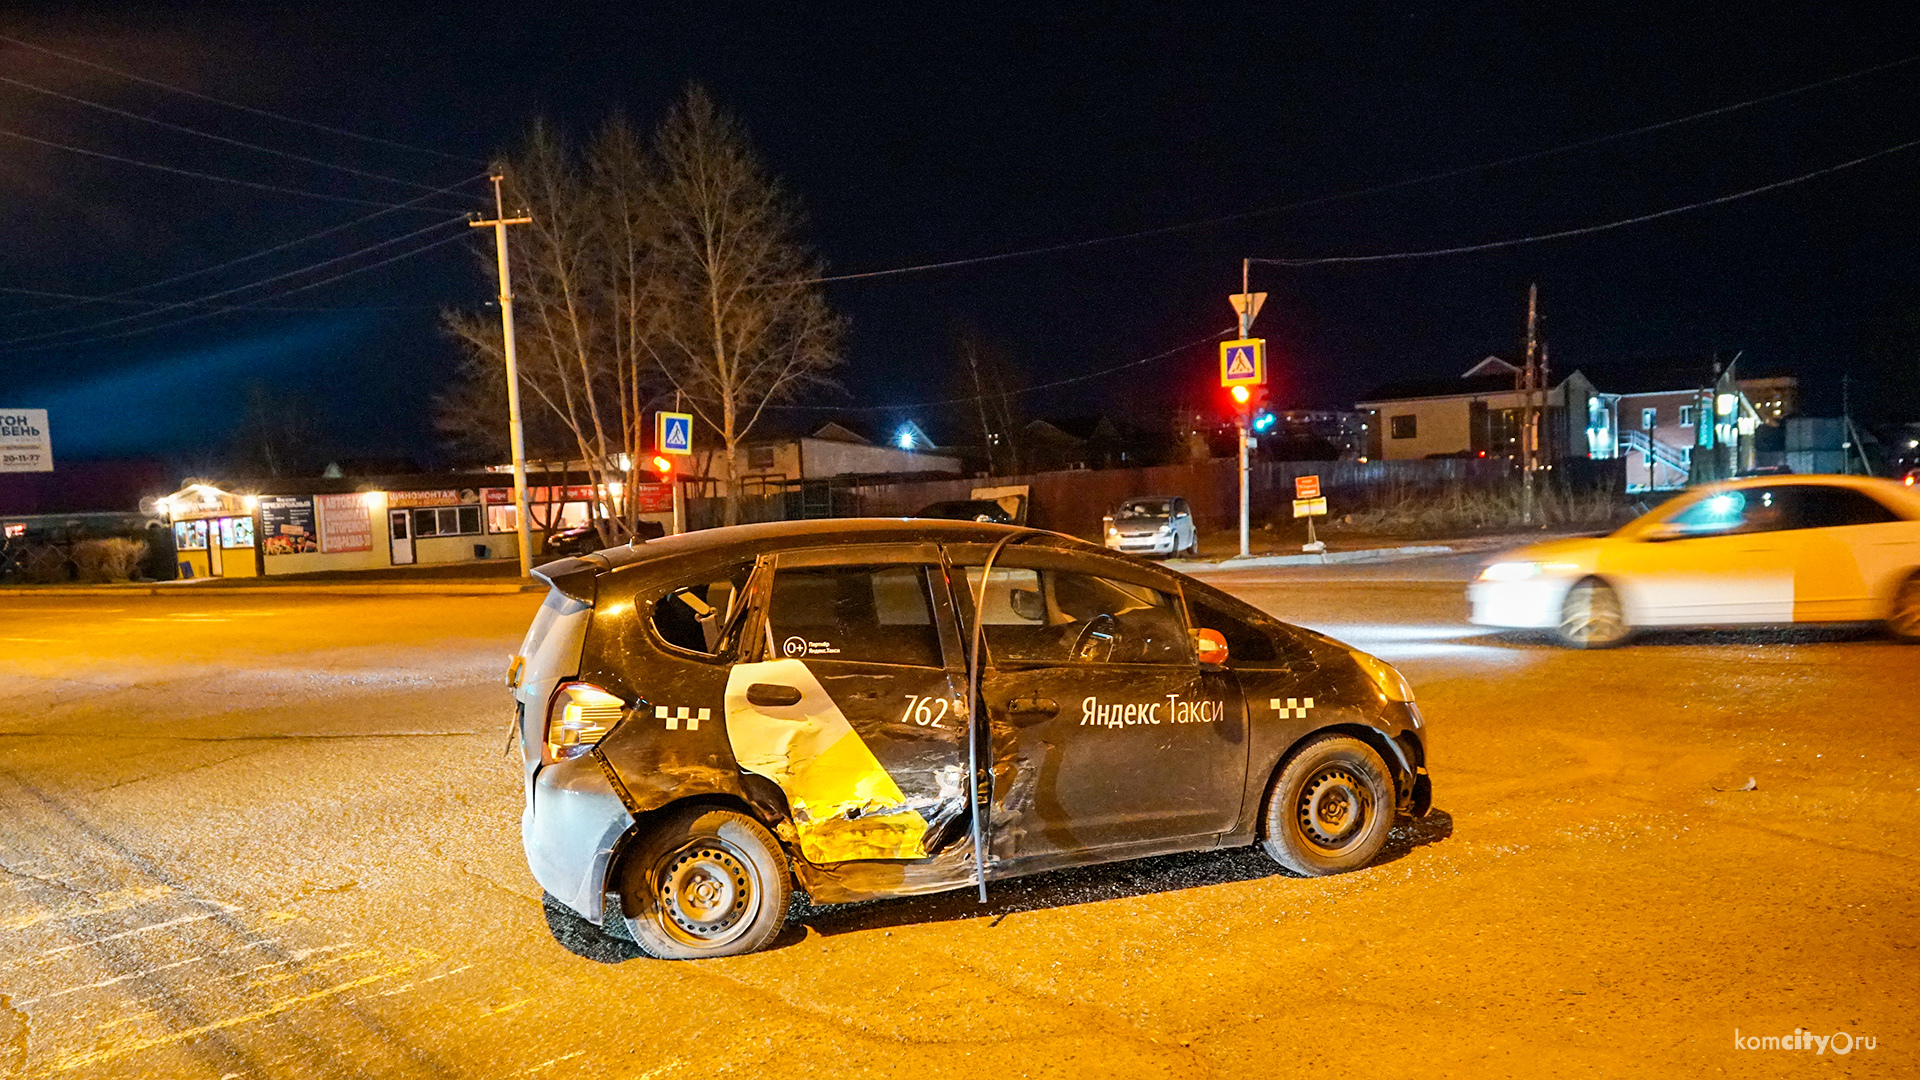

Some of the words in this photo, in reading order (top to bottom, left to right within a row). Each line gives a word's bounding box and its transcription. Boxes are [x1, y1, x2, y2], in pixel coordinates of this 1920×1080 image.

[389, 489, 457, 501] ШИНОМОНТАЖ
[901, 694, 949, 728] 762
[1080, 696, 1161, 729] Яндекс
[1166, 693, 1224, 724] Такси
